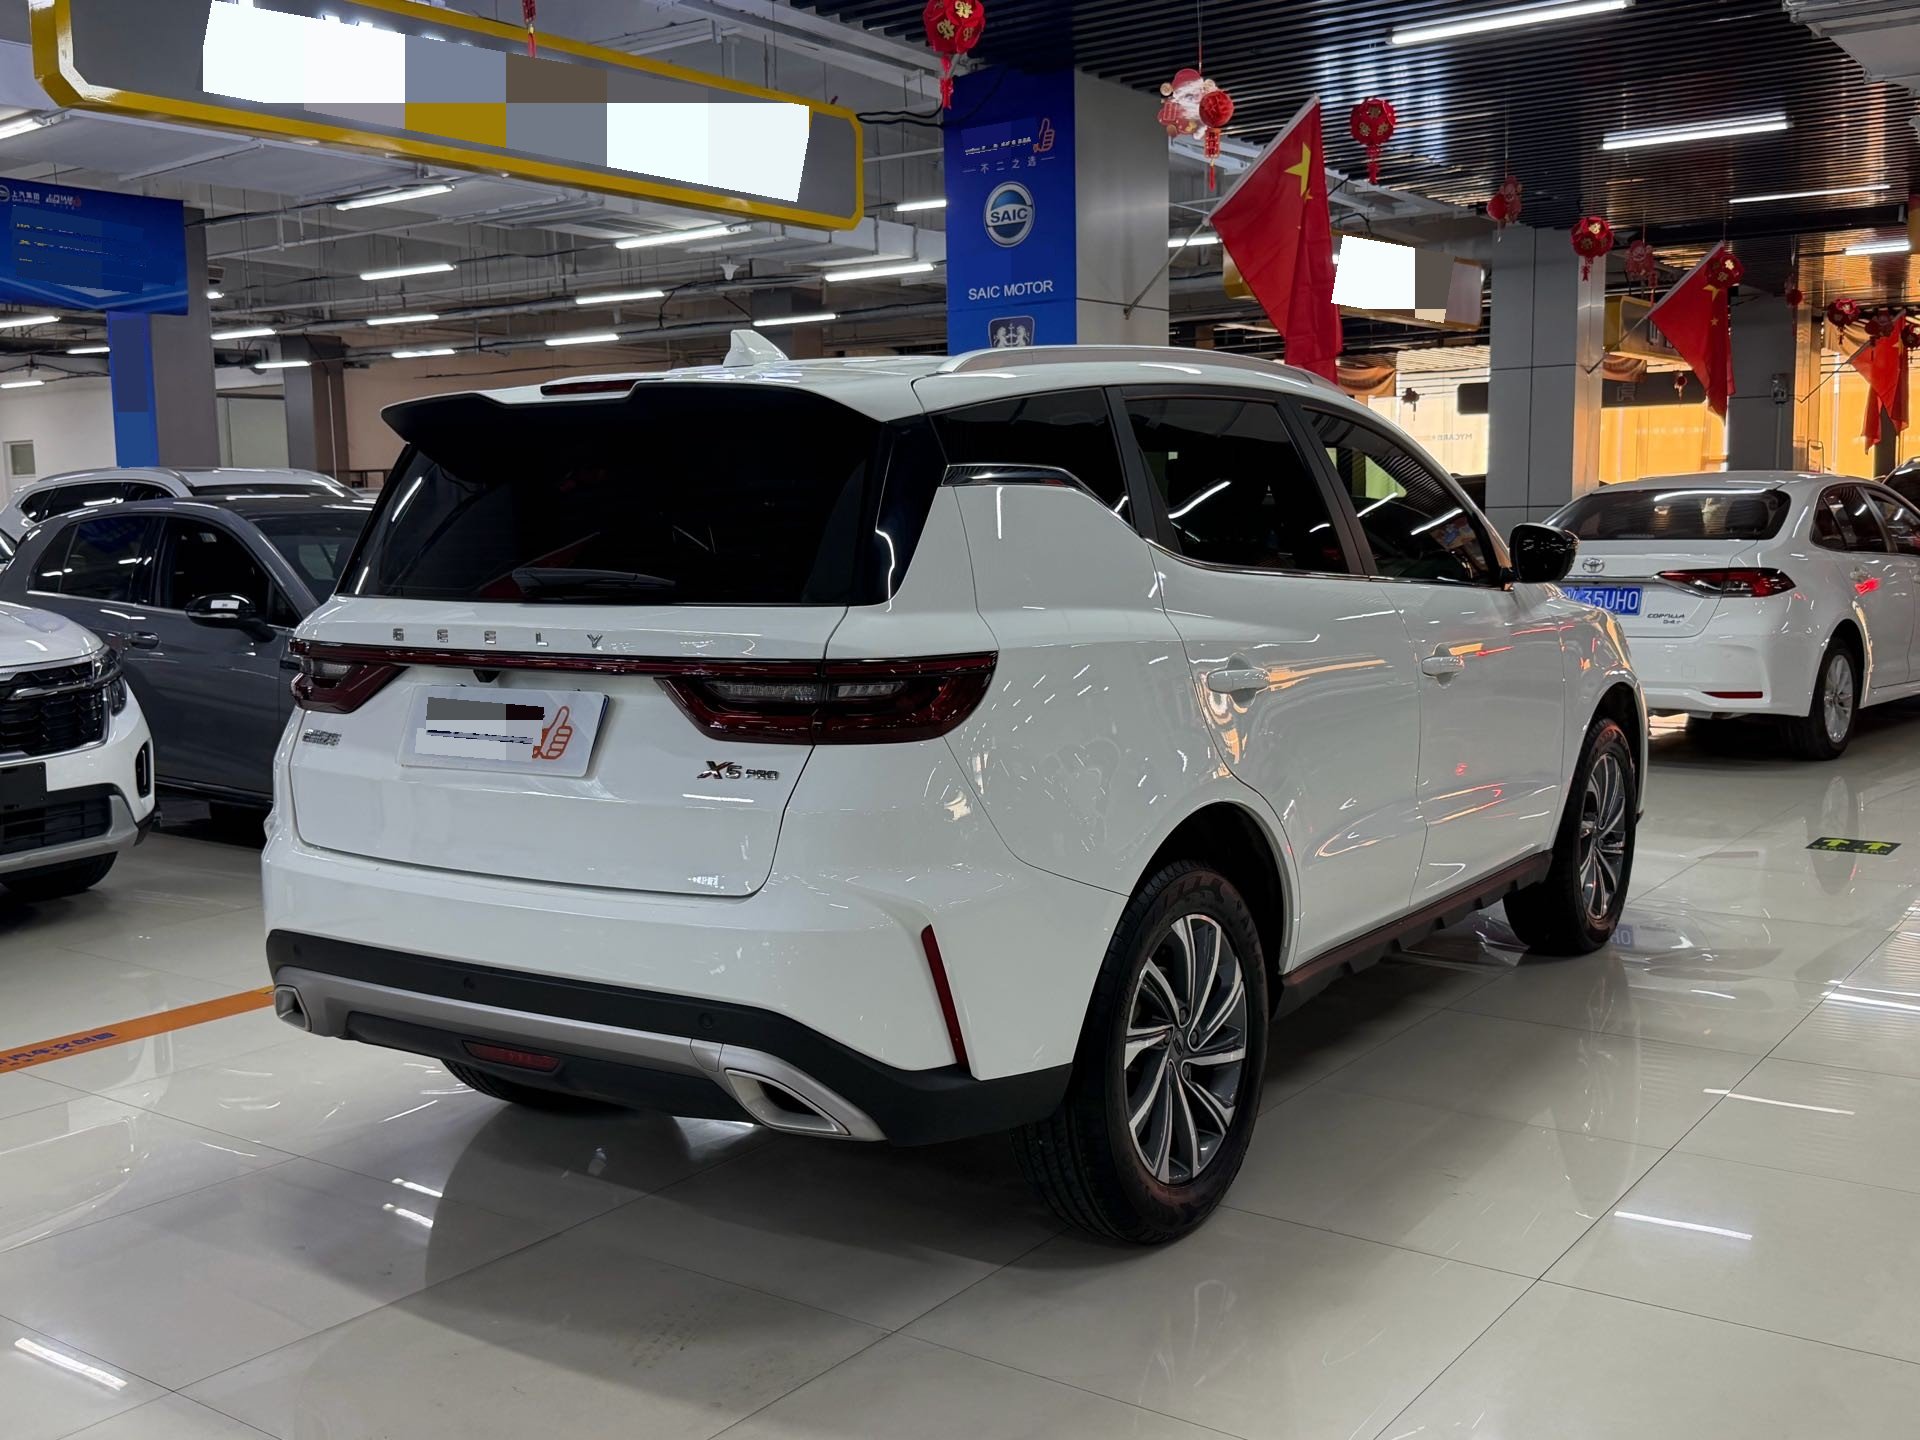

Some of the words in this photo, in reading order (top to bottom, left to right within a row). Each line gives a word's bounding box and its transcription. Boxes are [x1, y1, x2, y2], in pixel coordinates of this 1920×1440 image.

[990, 207, 1029, 224] SAIC
[968, 285, 1000, 301] SAIC
[1004, 279, 1054, 297] MOTOR
[392, 627, 604, 650] GEELY
[696, 760, 743, 780] X5
[745, 768, 779, 781] PRO
